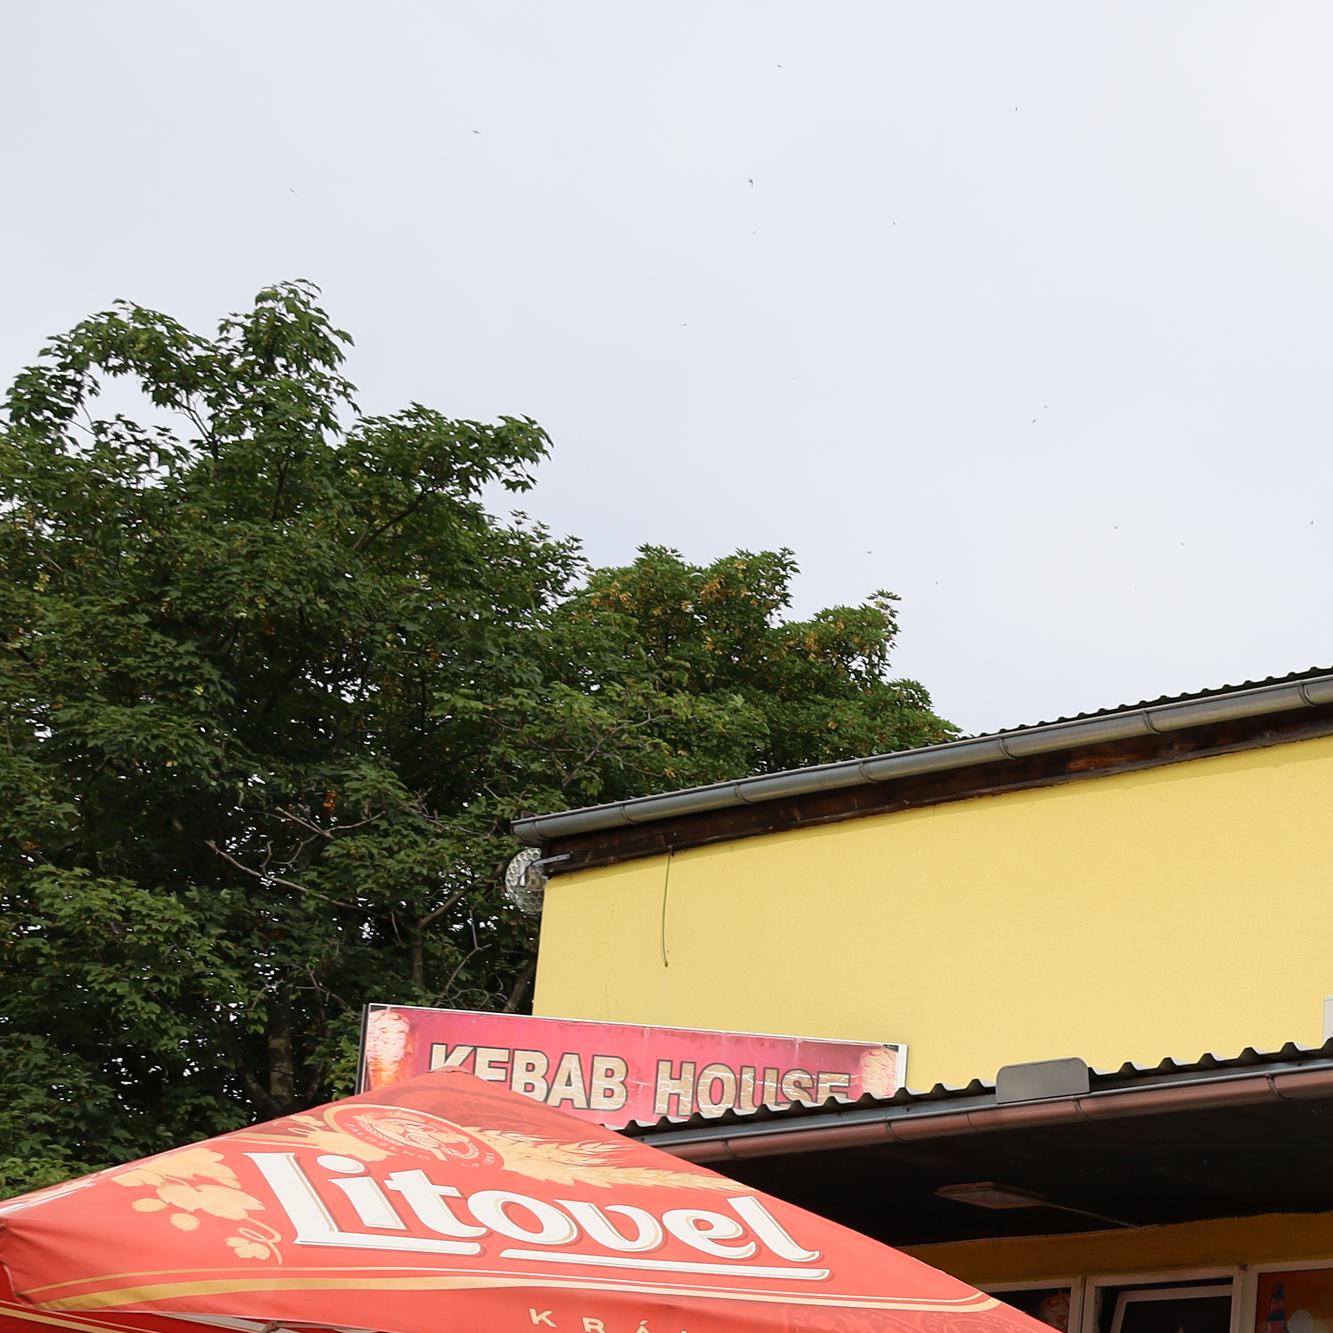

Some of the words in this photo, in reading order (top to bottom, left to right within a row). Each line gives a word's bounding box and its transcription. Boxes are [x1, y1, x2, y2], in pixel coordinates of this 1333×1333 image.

[429, 1042, 629, 1112] KEBAB
[654, 1059, 852, 1117] HOUSE
[243, 1152, 826, 1272] Litovel
